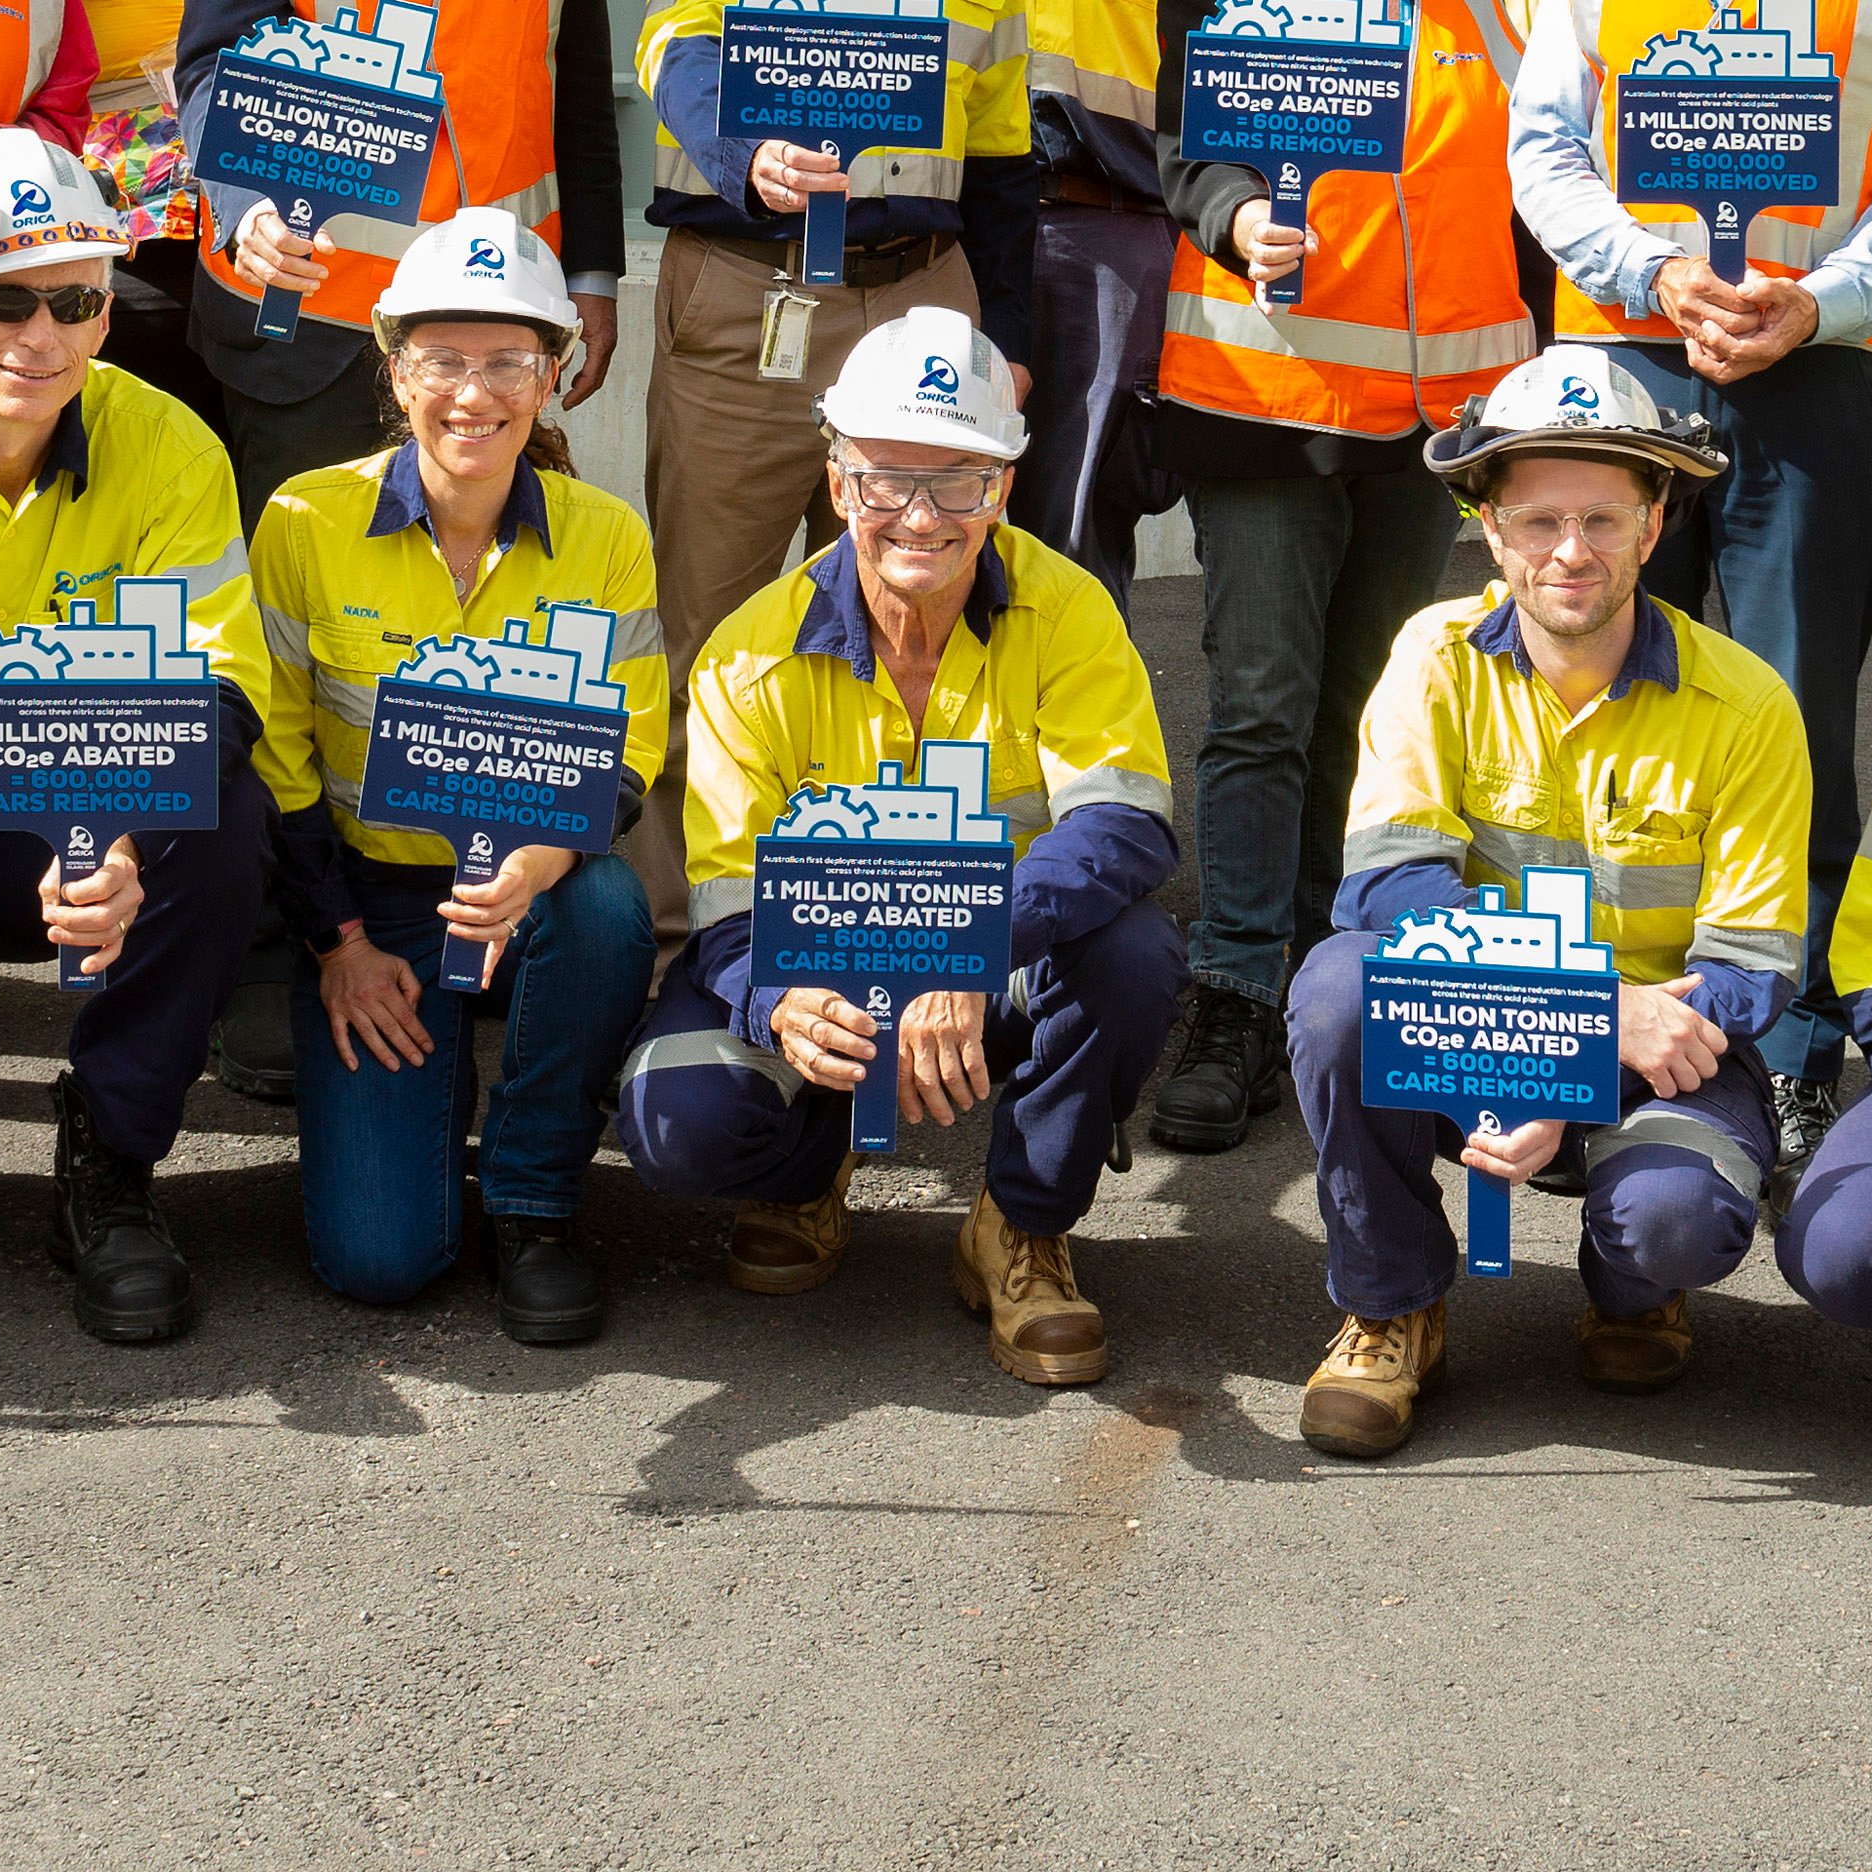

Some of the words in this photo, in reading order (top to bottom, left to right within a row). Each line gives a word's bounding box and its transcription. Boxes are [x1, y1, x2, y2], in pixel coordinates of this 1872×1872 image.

[729, 44, 740, 63] 1
[744, 45, 842, 68] MILLION
[845, 50, 940, 73] TONNES
[816, 69, 912, 92] ABATED
[791, 88, 892, 111] 600,000
[740, 106, 803, 127] CARS
[808, 109, 923, 133] REMOVED
[12, 214, 56, 229] ORICA
[915, 391, 958, 406] ORICA
[915, 405, 977, 425] WATERMAN
[342, 604, 380, 620] NADIA
[93, 721, 208, 743] TONNES
[379, 718, 392, 739] 1
[396, 720, 506, 755] MILLION
[509, 736, 615, 770] TONNES
[60, 745, 176, 766] ABATED
[31, 769, 152, 791] 600,000
[474, 755, 582, 787] ABATED
[53, 792, 191, 813] REMOVED
[444, 773, 556, 807] 600,000
[385, 787, 456, 815] CARS
[460, 797, 589, 833] REMOVED
[762, 879, 775, 900] 1
[780, 879, 891, 903] MILLION
[895, 882, 1004, 906] TONNES
[863, 905, 973, 928] ABATED
[834, 928, 949, 952] 600,000
[776, 949, 848, 972] CARS
[854, 951, 986, 975] REMOVED
[1370, 999, 1383, 1020] 1
[1388, 1000, 1497, 1028] MILLION
[1501, 1008, 1611, 1036] TONNES
[1470, 1029, 1580, 1057] ABATED
[1442, 1051, 1557, 1079] 600,000
[1386, 1070, 1457, 1095] CARS
[1463, 1075, 1595, 1105] REMOVED
